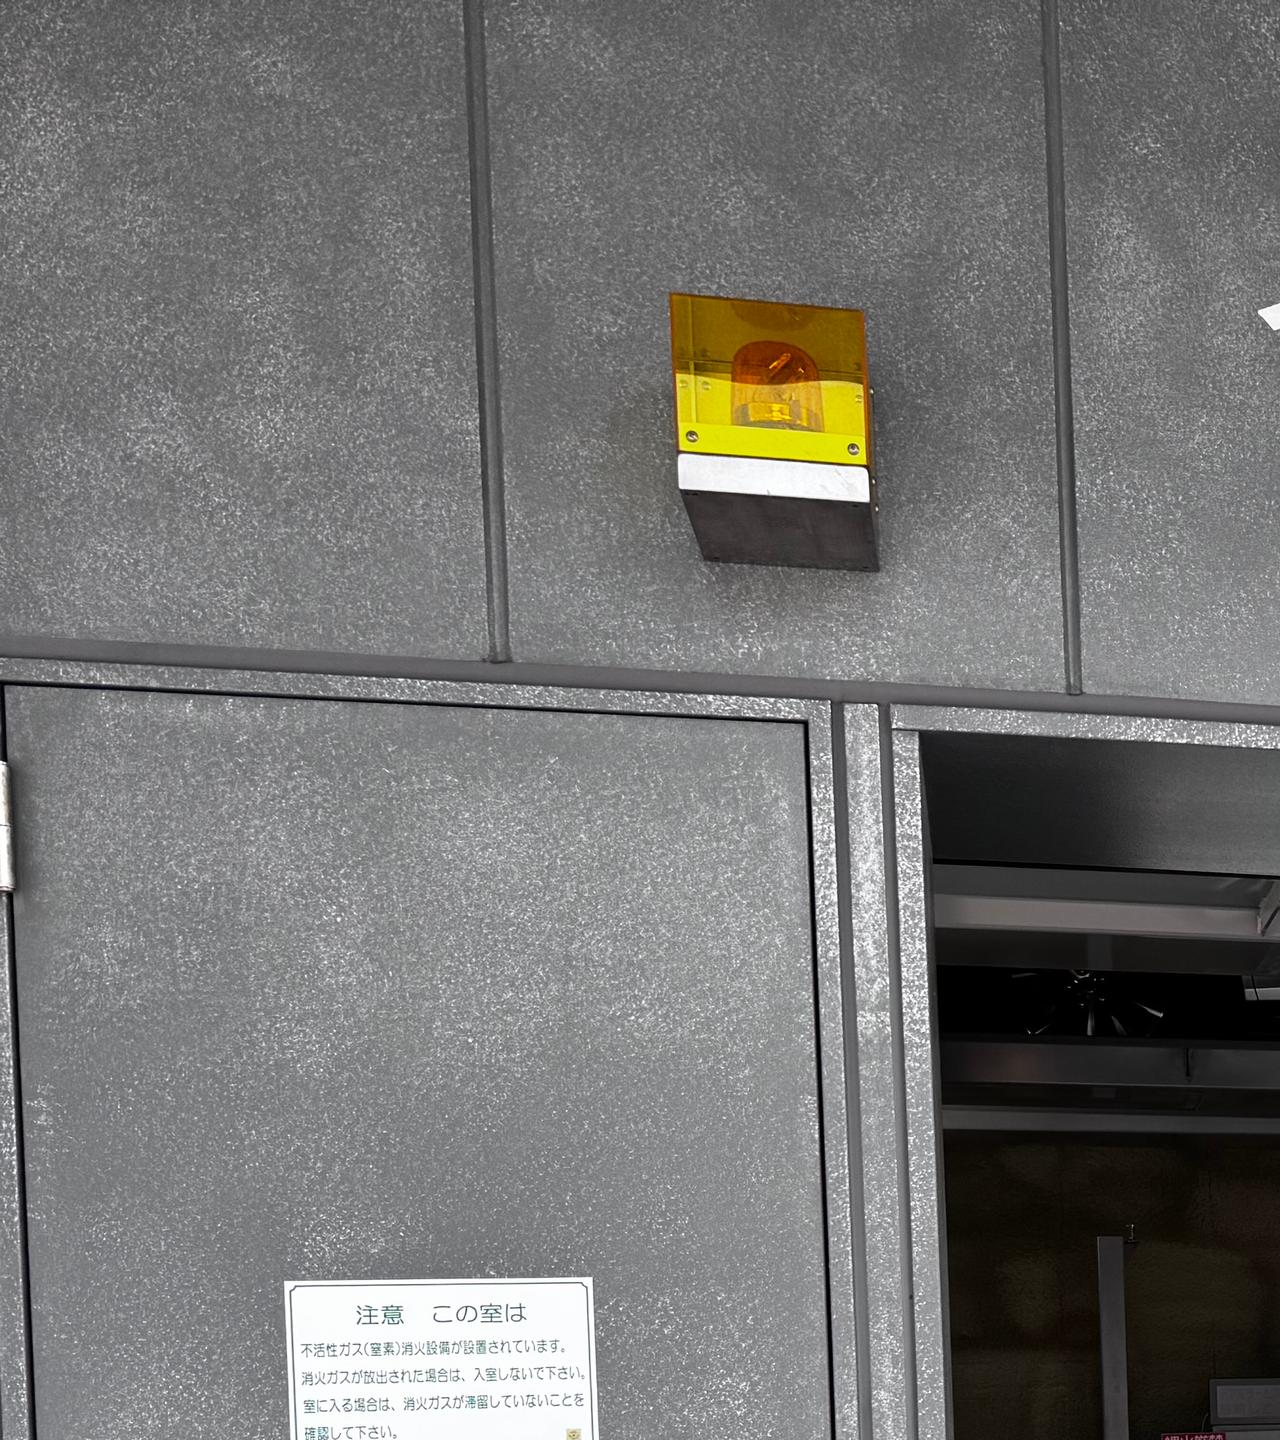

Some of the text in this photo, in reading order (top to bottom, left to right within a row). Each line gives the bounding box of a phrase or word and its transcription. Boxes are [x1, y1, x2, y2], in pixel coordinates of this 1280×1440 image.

[356, 1302, 528, 1326] 注意 この室は
[301, 1366, 587, 1387] 消火ガスが放出された場合は、入室しないで下さい。
